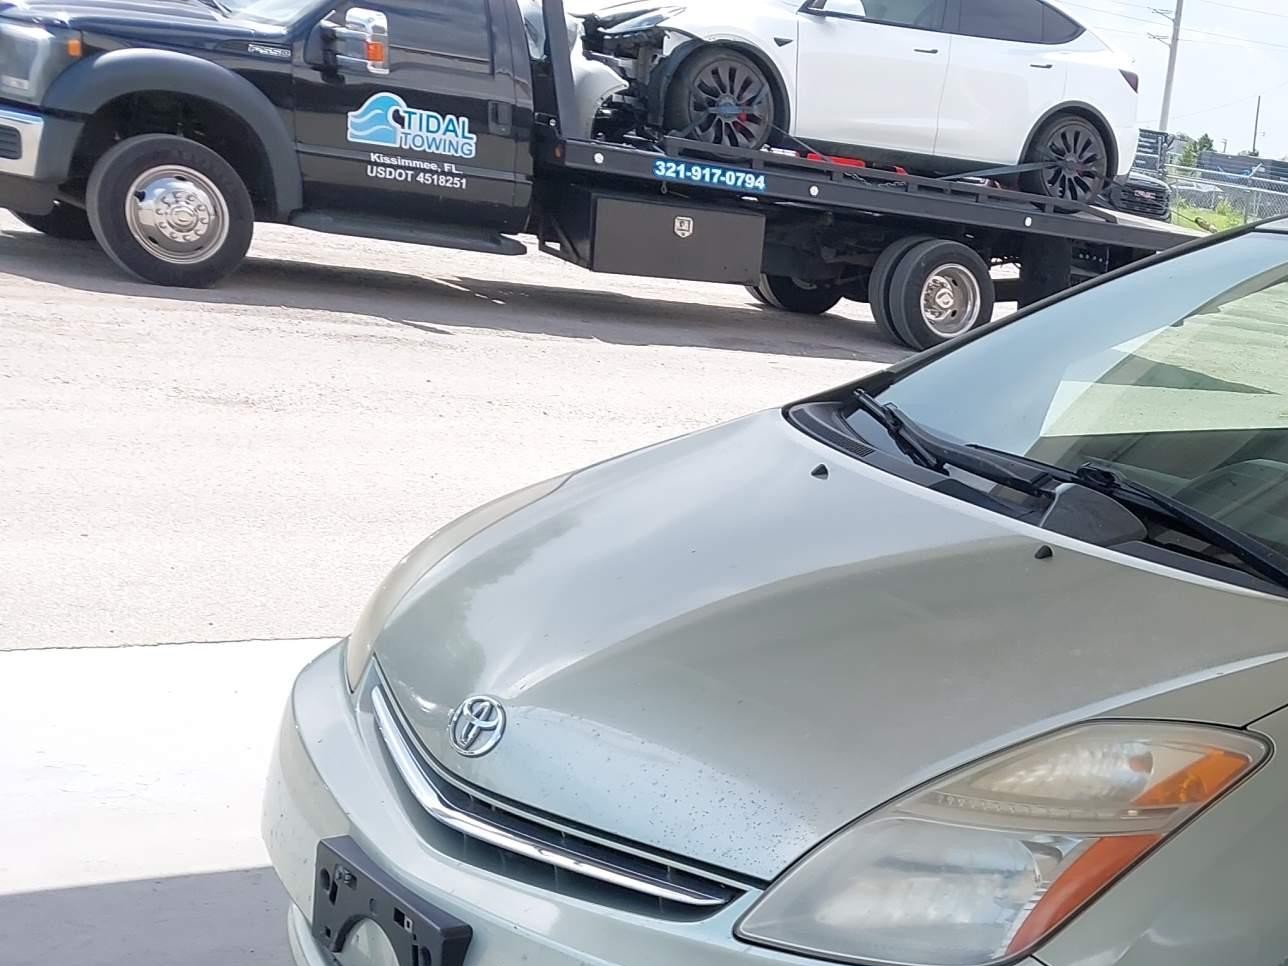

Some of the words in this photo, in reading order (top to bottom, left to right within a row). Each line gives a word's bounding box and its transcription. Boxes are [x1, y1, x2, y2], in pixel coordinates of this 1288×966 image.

[403, 109, 475, 141] TIDAL
[401, 131, 474, 157] TOWING
[370, 152, 442, 173] Kissimmee,
[655, 160, 766, 190] 321-917-0794
[366, 165, 414, 182] USDOT
[416, 172, 467, 189] 4518251
